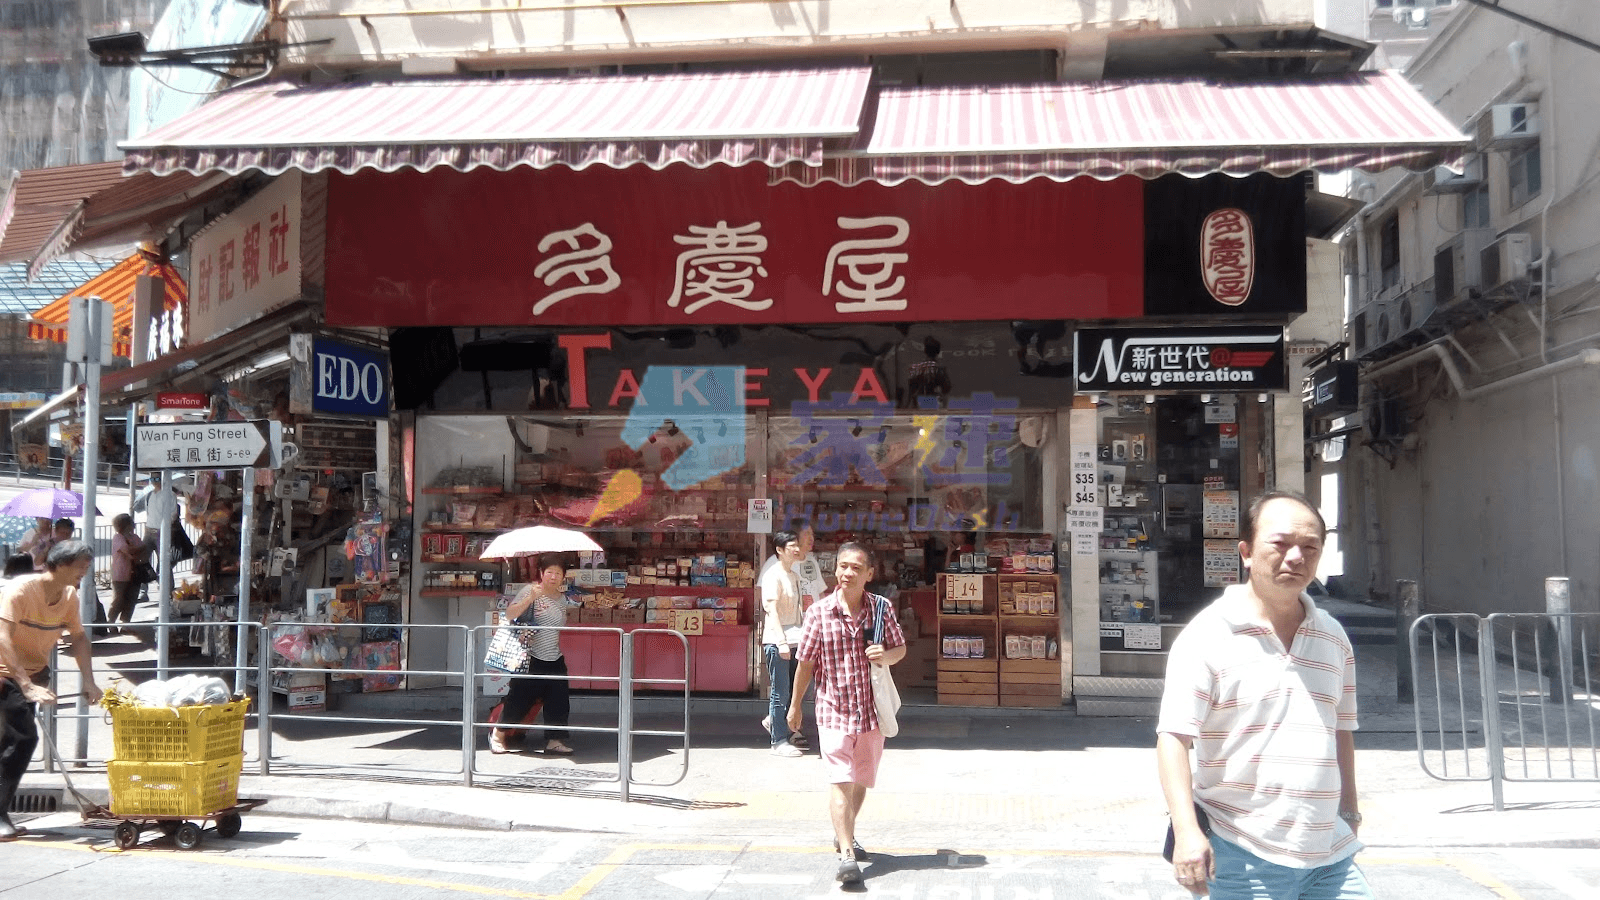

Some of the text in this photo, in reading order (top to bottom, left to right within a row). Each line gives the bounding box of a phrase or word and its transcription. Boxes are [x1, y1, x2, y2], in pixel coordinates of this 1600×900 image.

[198, 204, 289, 317] 財記報社
[532, 216, 910, 316] 多慶屋
[1207, 211, 1248, 301] 多慶屋
[1079, 337, 1254, 387] New generation
[1131, 346, 1210, 370] 新世代
[316, 351, 384, 405] EDO
[557, 331, 891, 409] TAKEYA
[160, 396, 201, 406] SmarTone
[141, 427, 247, 442] Wan Fung Street
[167, 447, 251, 463] 環鳳街 5-69
[1075, 473, 1094, 484] $35
[1075, 492, 1095, 503] $45
[961, 582, 978, 597] 14
[682, 616, 700, 631] 13
